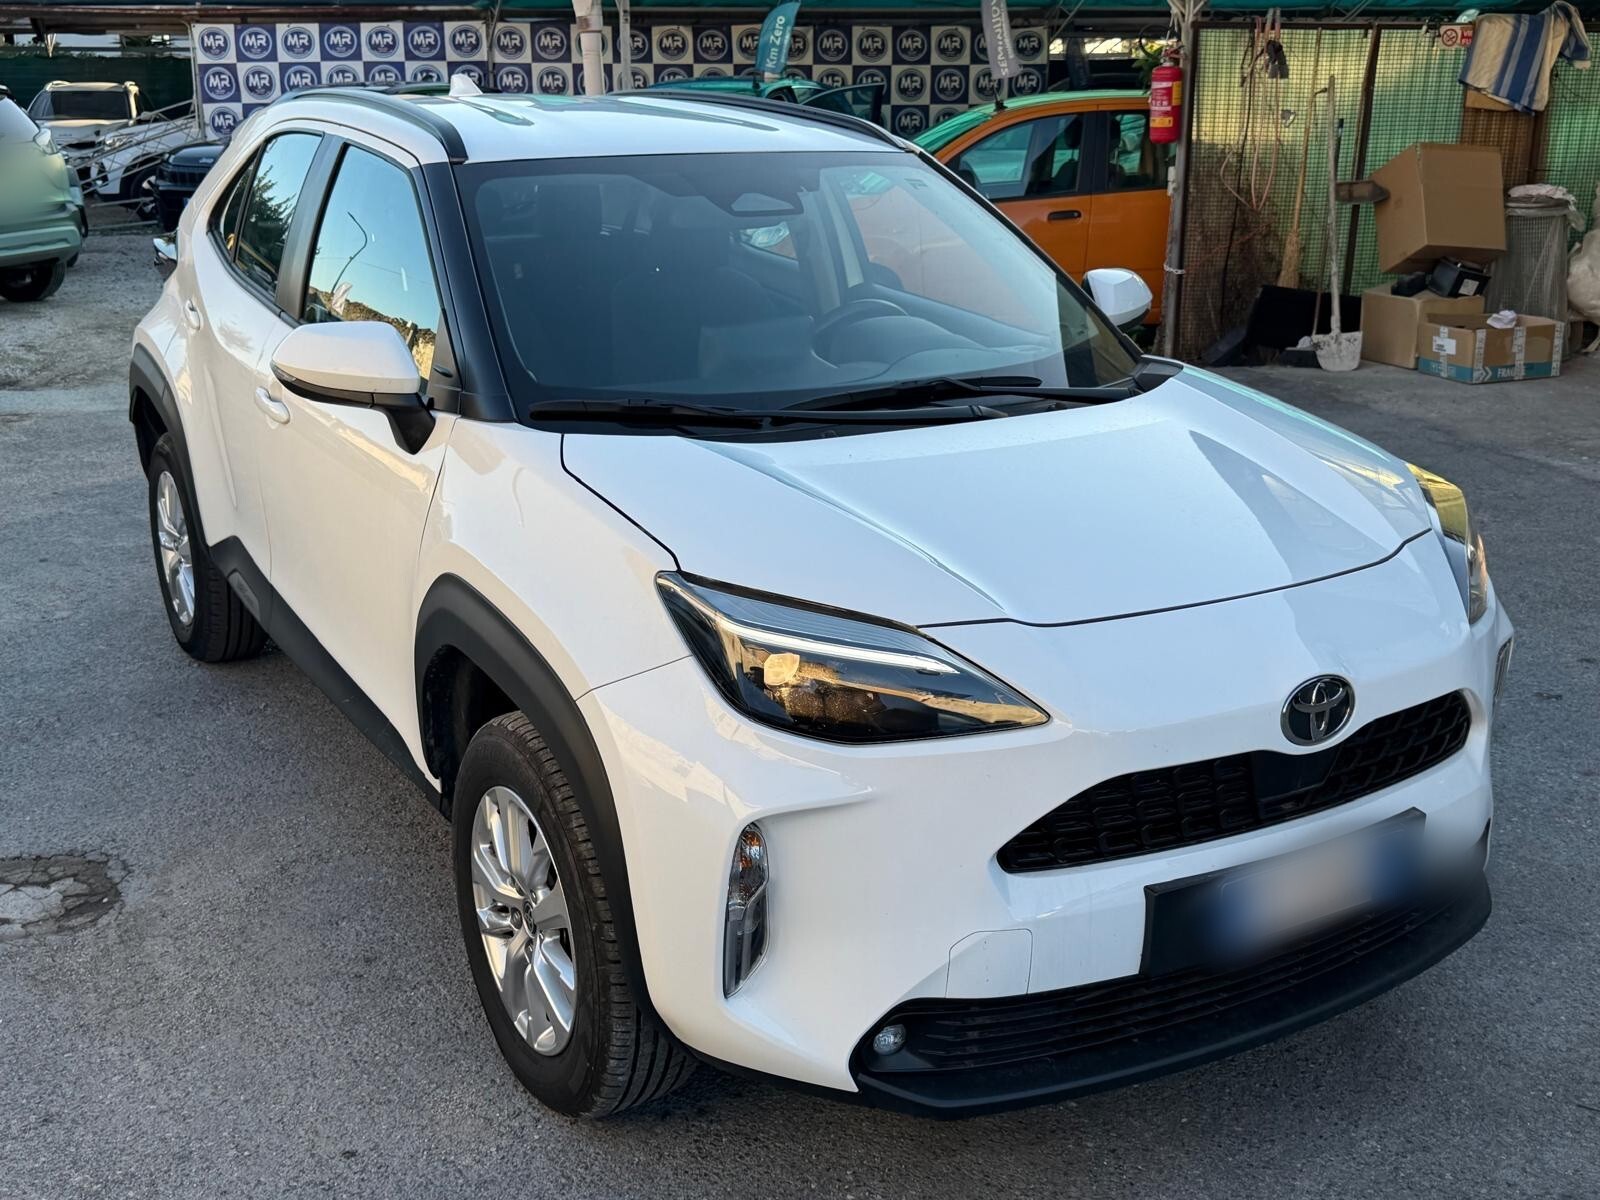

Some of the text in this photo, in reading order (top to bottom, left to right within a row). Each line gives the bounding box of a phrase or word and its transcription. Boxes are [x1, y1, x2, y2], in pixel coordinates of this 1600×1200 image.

[204, 34, 225, 49] MR
[244, 34, 267, 49] MR
[287, 34, 309, 48] MR
[329, 32, 352, 47] MR
[371, 32, 394, 47] MR
[413, 32, 436, 47] MR
[455, 32, 477, 47] MR
[500, 34, 521, 49] MR
[540, 35, 562, 49] MR
[662, 36, 683, 49] MR
[702, 37, 723, 49] MR
[765, 15, 785, 69] Km Zero
[822, 36, 843, 50] MR
[861, 36, 882, 50] MR
[901, 36, 922, 50] MR
[941, 36, 961, 50] MR
[1018, 37, 1039, 50] MR
[209, 74, 230, 90] MR
[248, 73, 270, 89] MR
[290, 73, 312, 87] MR
[502, 74, 523, 89] MR
[542, 75, 563, 90] MR
[900, 75, 921, 90] MR
[940, 75, 960, 90] MR
[1017, 75, 1038, 90] MR
[214, 117, 235, 130] MR
[900, 115, 920, 129] MR
